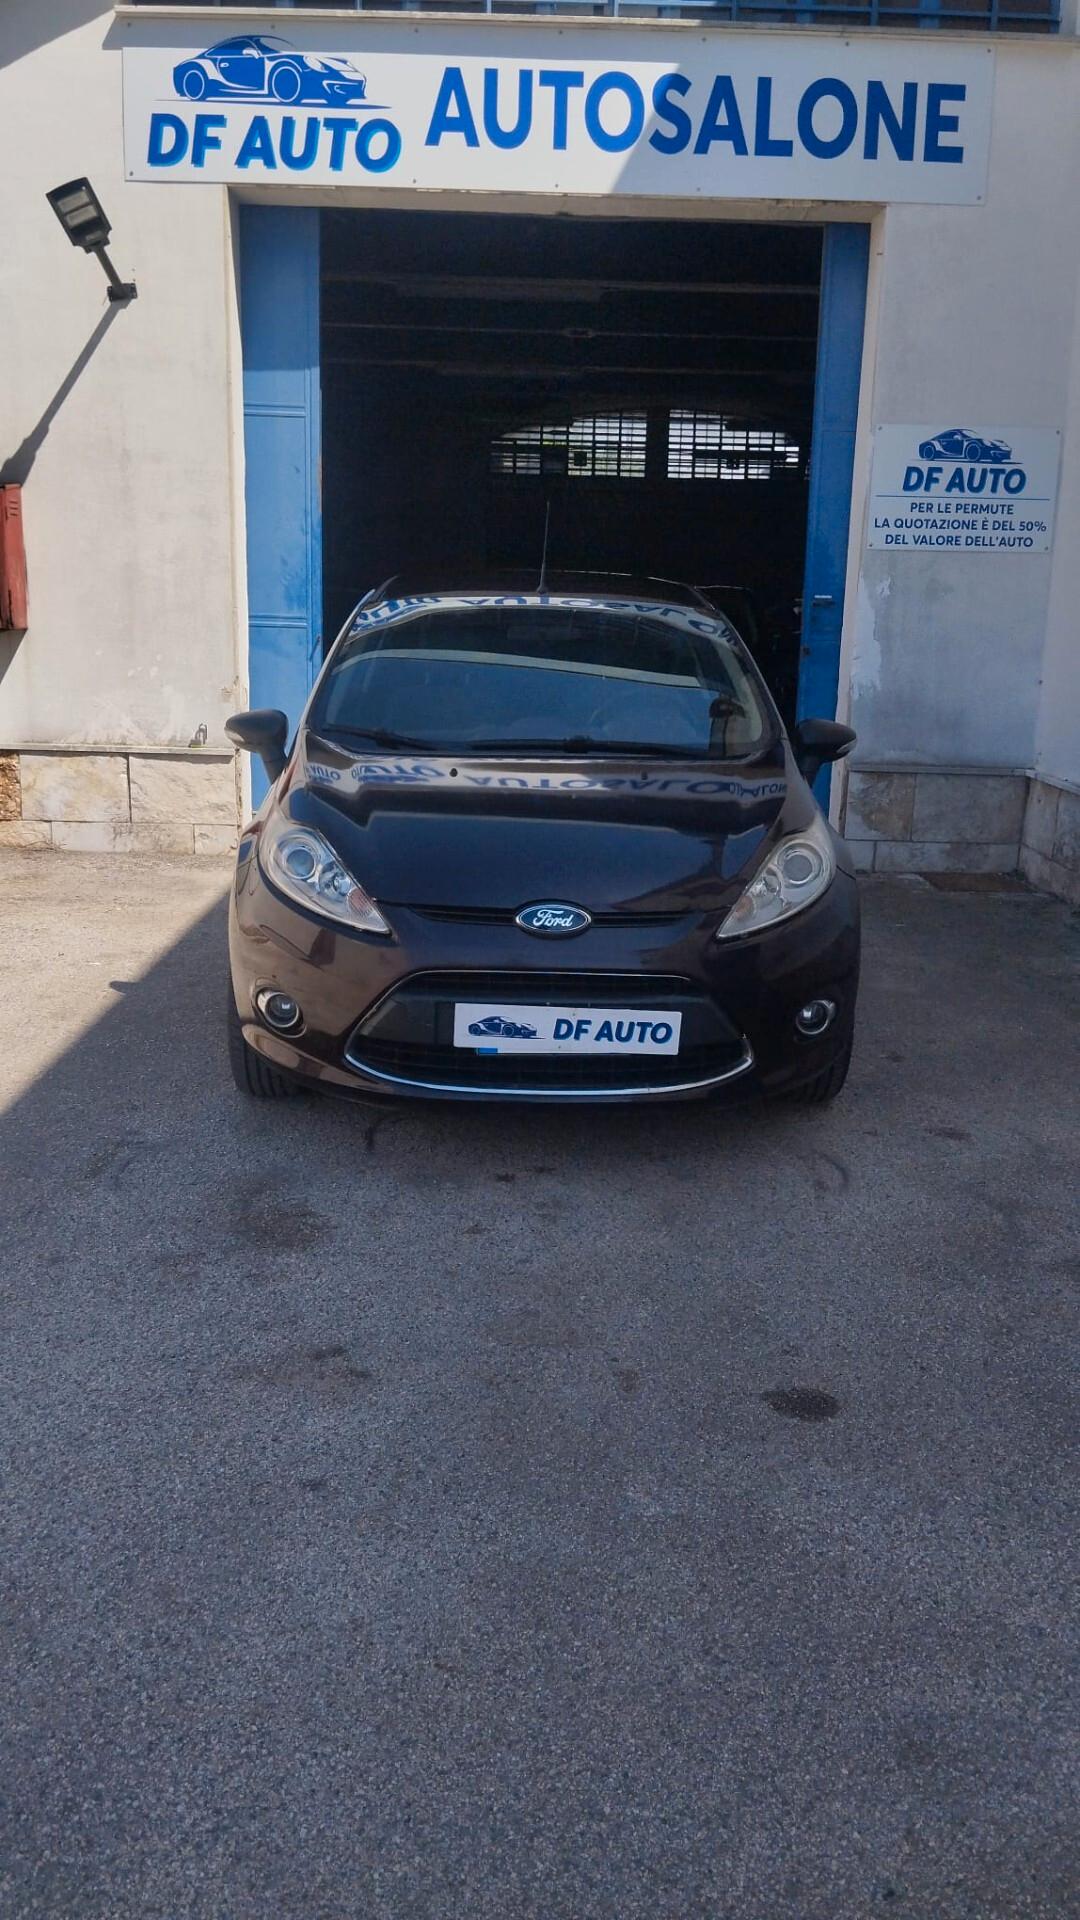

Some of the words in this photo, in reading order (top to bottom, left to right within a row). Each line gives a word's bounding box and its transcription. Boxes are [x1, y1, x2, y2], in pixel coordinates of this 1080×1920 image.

[424, 66, 967, 164] AUTOSALONE
[147, 112, 227, 168] DF
[234, 115, 402, 174] AUTO
[902, 466, 943, 493] DF
[945, 467, 1027, 494] AUTO
[910, 502, 934, 514] PER
[937, 503, 952, 514] LE
[955, 503, 1014, 515] PERMUTE
[874, 518, 890, 529] LA
[894, 518, 978, 531] QUOTAZIONE
[981, 517, 989, 531] È
[992, 520, 1015, 531] DEL
[1018, 520, 1047, 532] 50%
[885, 534, 909, 545] DEL
[912, 534, 961, 546] VALORE
[965, 536, 1034, 548] DELL'AUTO
[532, 909, 573, 928] Ford
[553, 1018, 592, 1041] DF
[594, 1020, 673, 1045] AUTO
